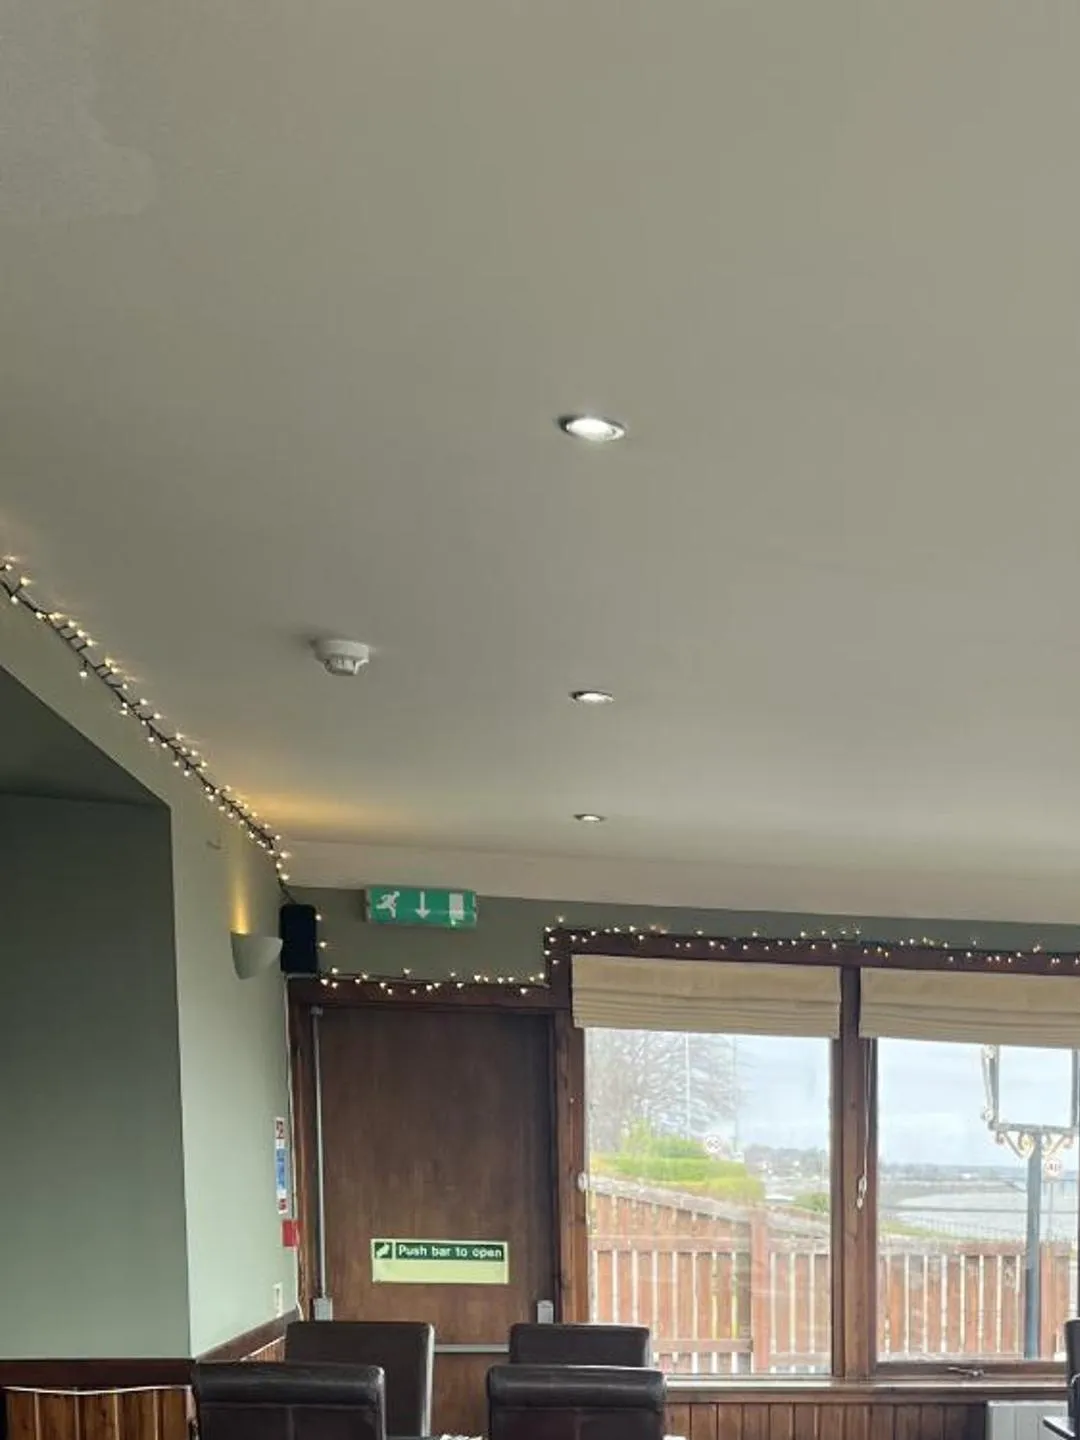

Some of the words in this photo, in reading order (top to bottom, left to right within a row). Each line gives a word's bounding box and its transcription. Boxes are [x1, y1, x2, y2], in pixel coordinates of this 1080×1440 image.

[399, 1244, 427, 1257] Push
[432, 1246, 451, 1257] bar
[455, 1247, 468, 1257] to
[472, 1248, 502, 1258] open
